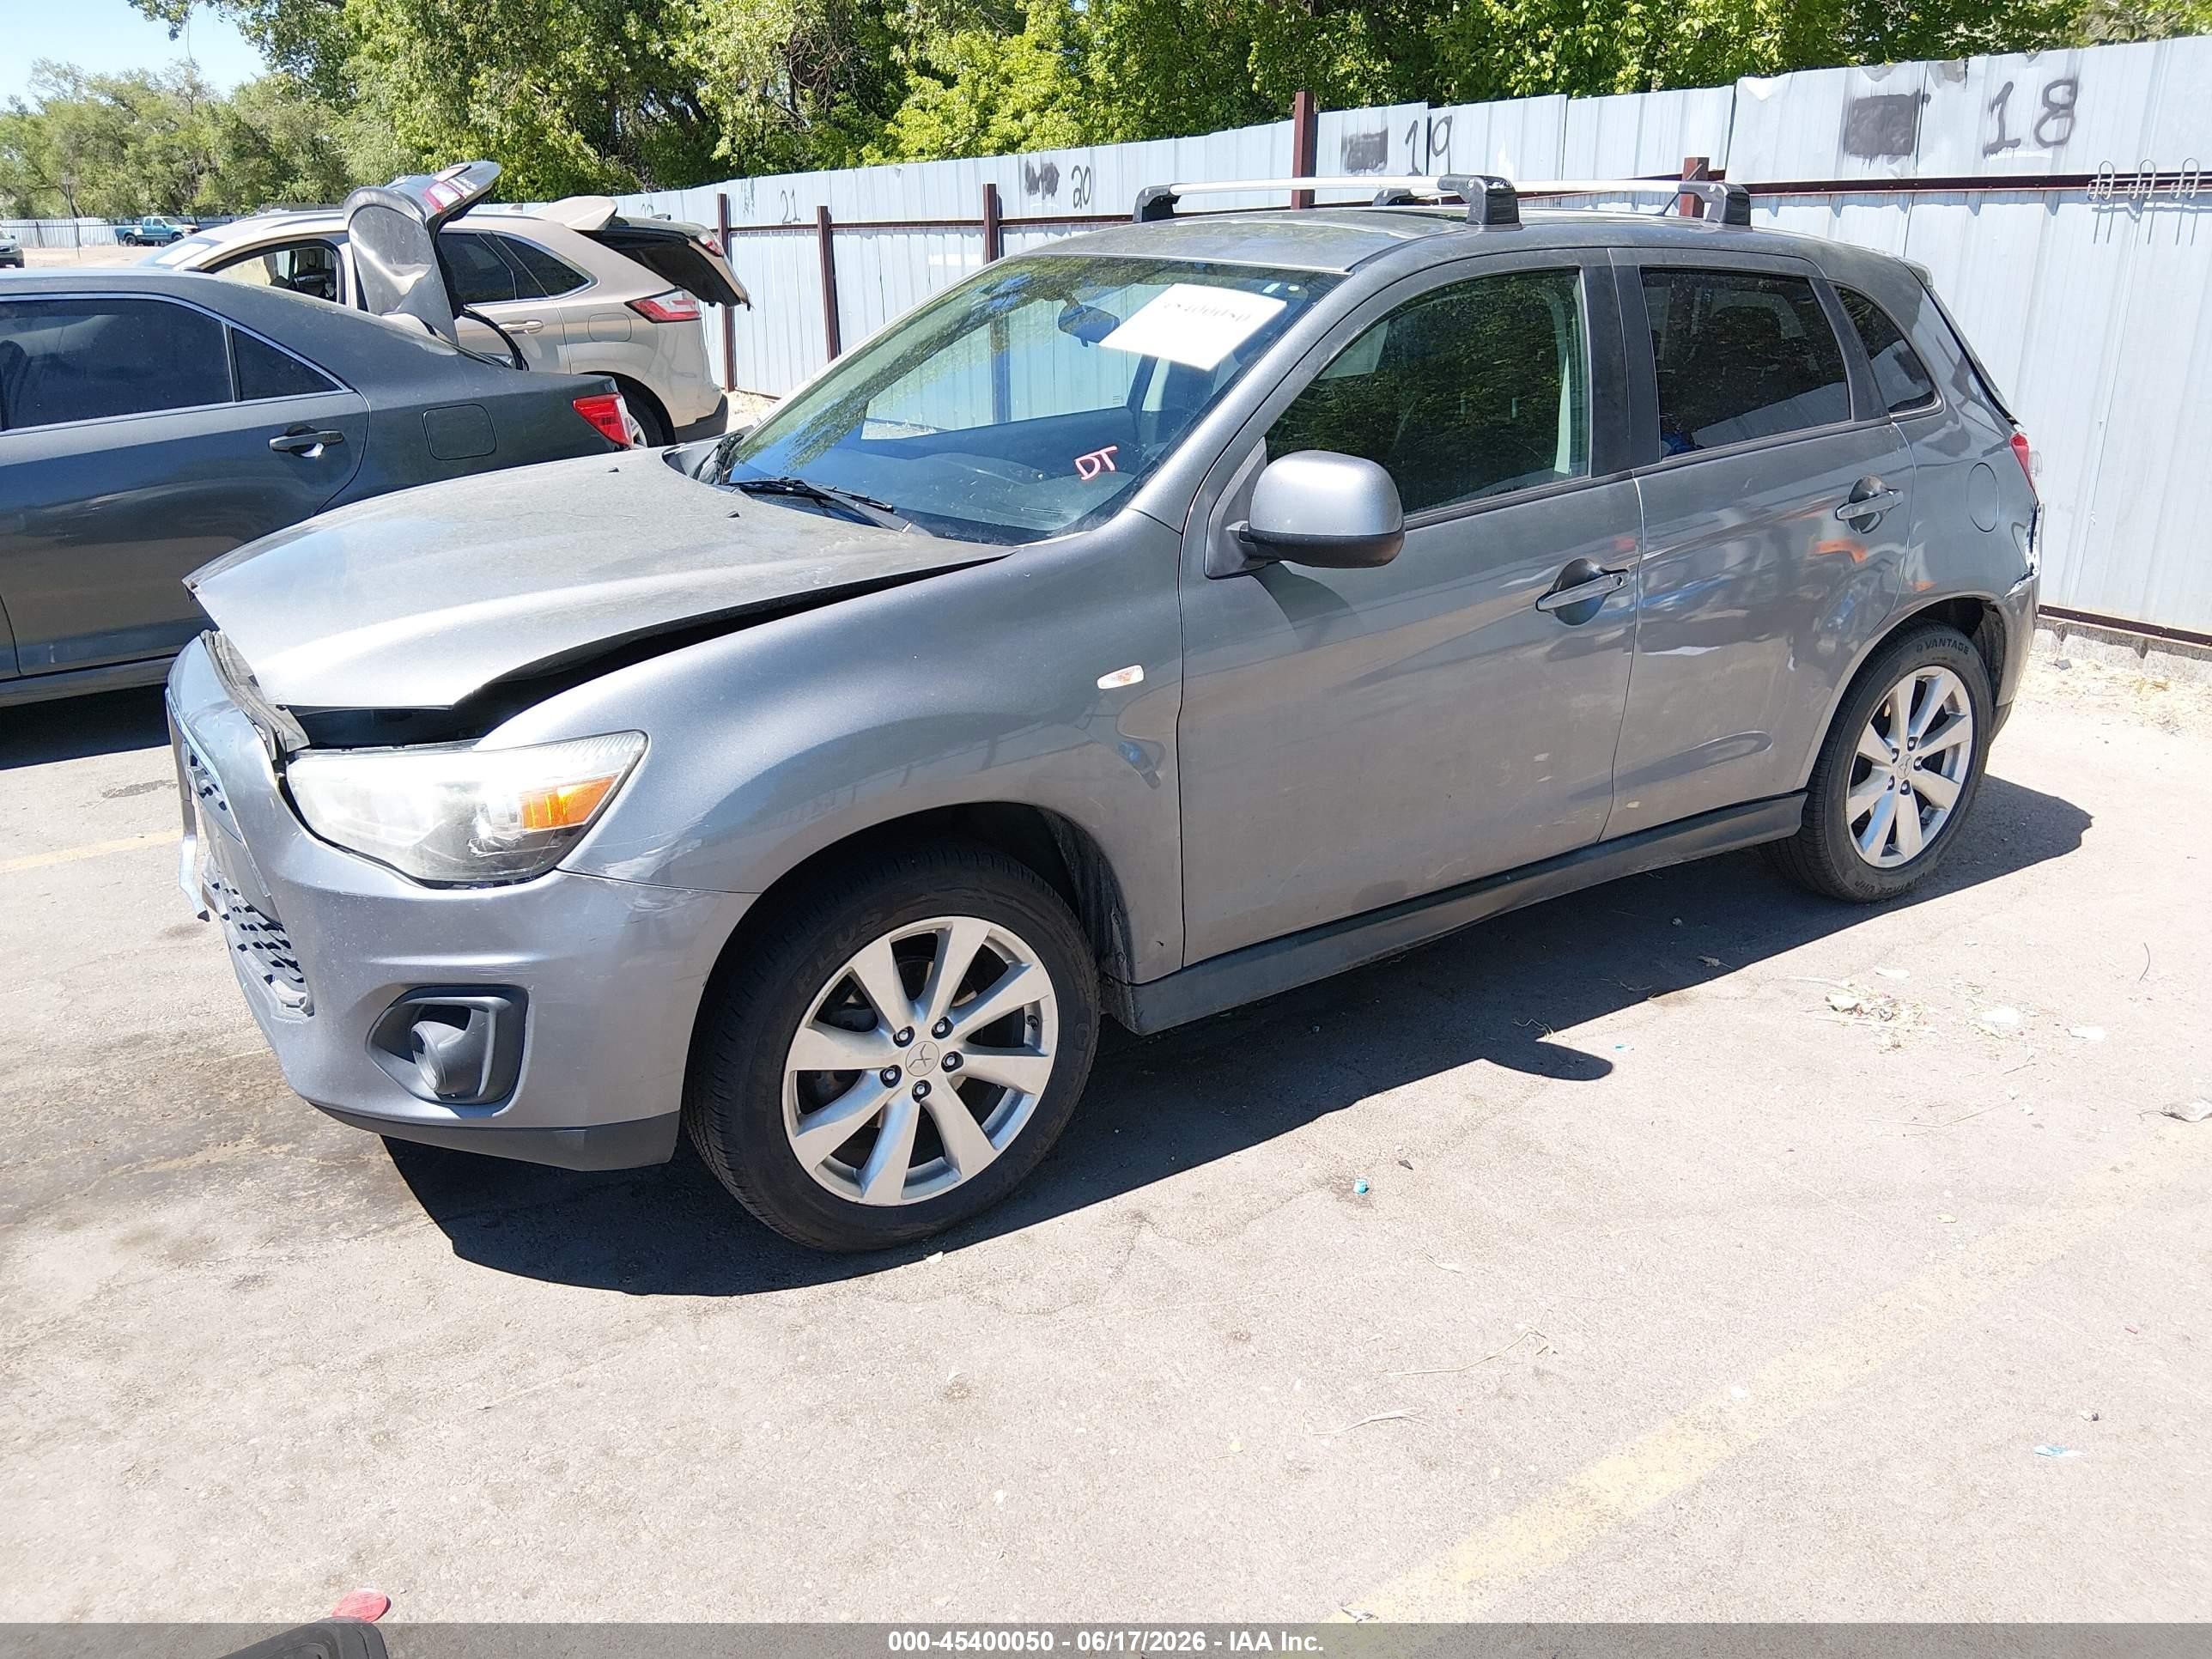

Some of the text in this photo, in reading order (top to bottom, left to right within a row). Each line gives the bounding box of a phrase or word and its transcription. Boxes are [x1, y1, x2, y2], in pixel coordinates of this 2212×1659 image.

[1983, 78, 2079, 159] 18
[1405, 114, 1453, 176] 19
[780, 188, 801, 225] 21
[1071, 165, 1091, 210] 20
[1073, 445, 1119, 481] DT
